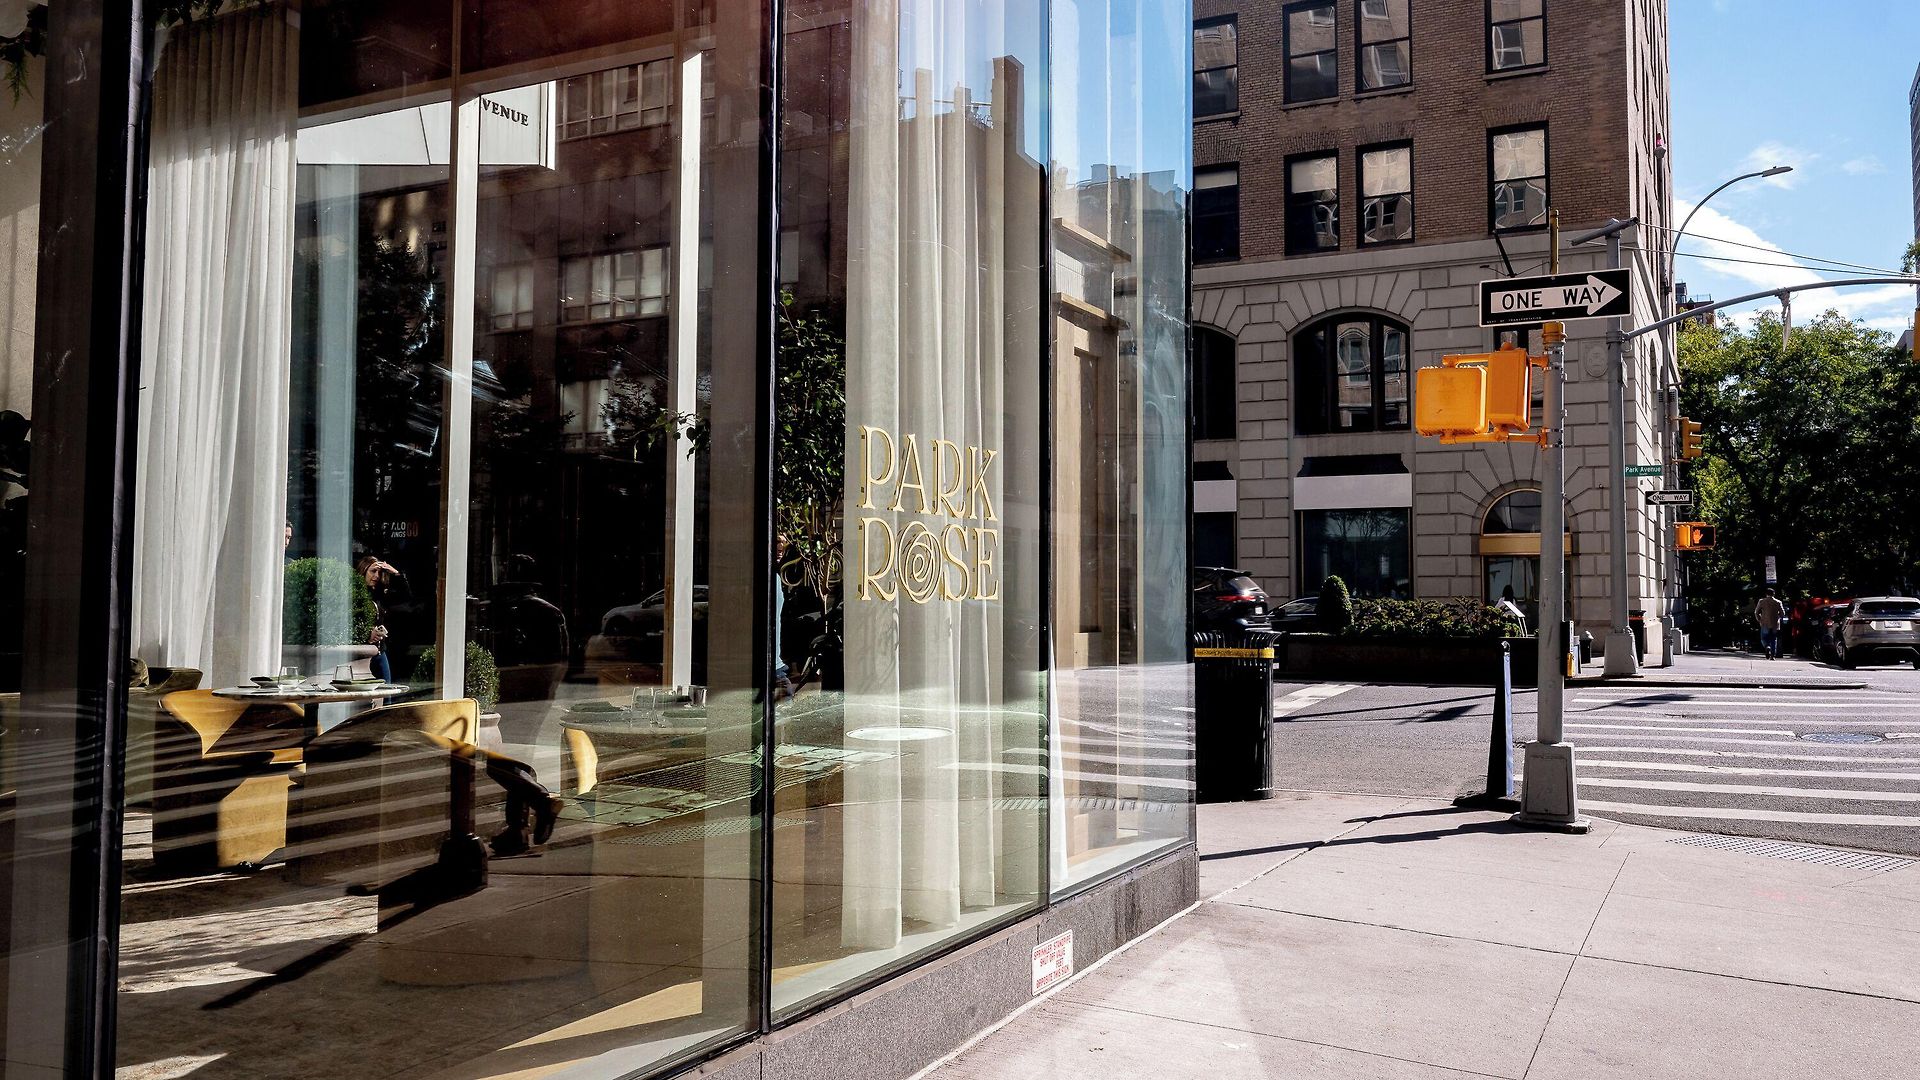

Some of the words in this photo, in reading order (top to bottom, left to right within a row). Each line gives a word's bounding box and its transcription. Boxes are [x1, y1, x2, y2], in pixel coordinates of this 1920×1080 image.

[481, 98, 529, 127] VENUE
[1502, 291, 1543, 310] ONE
[1563, 286, 1606, 306] WAY
[858, 425, 998, 521] PARK
[858, 517, 999, 604] ROSE
